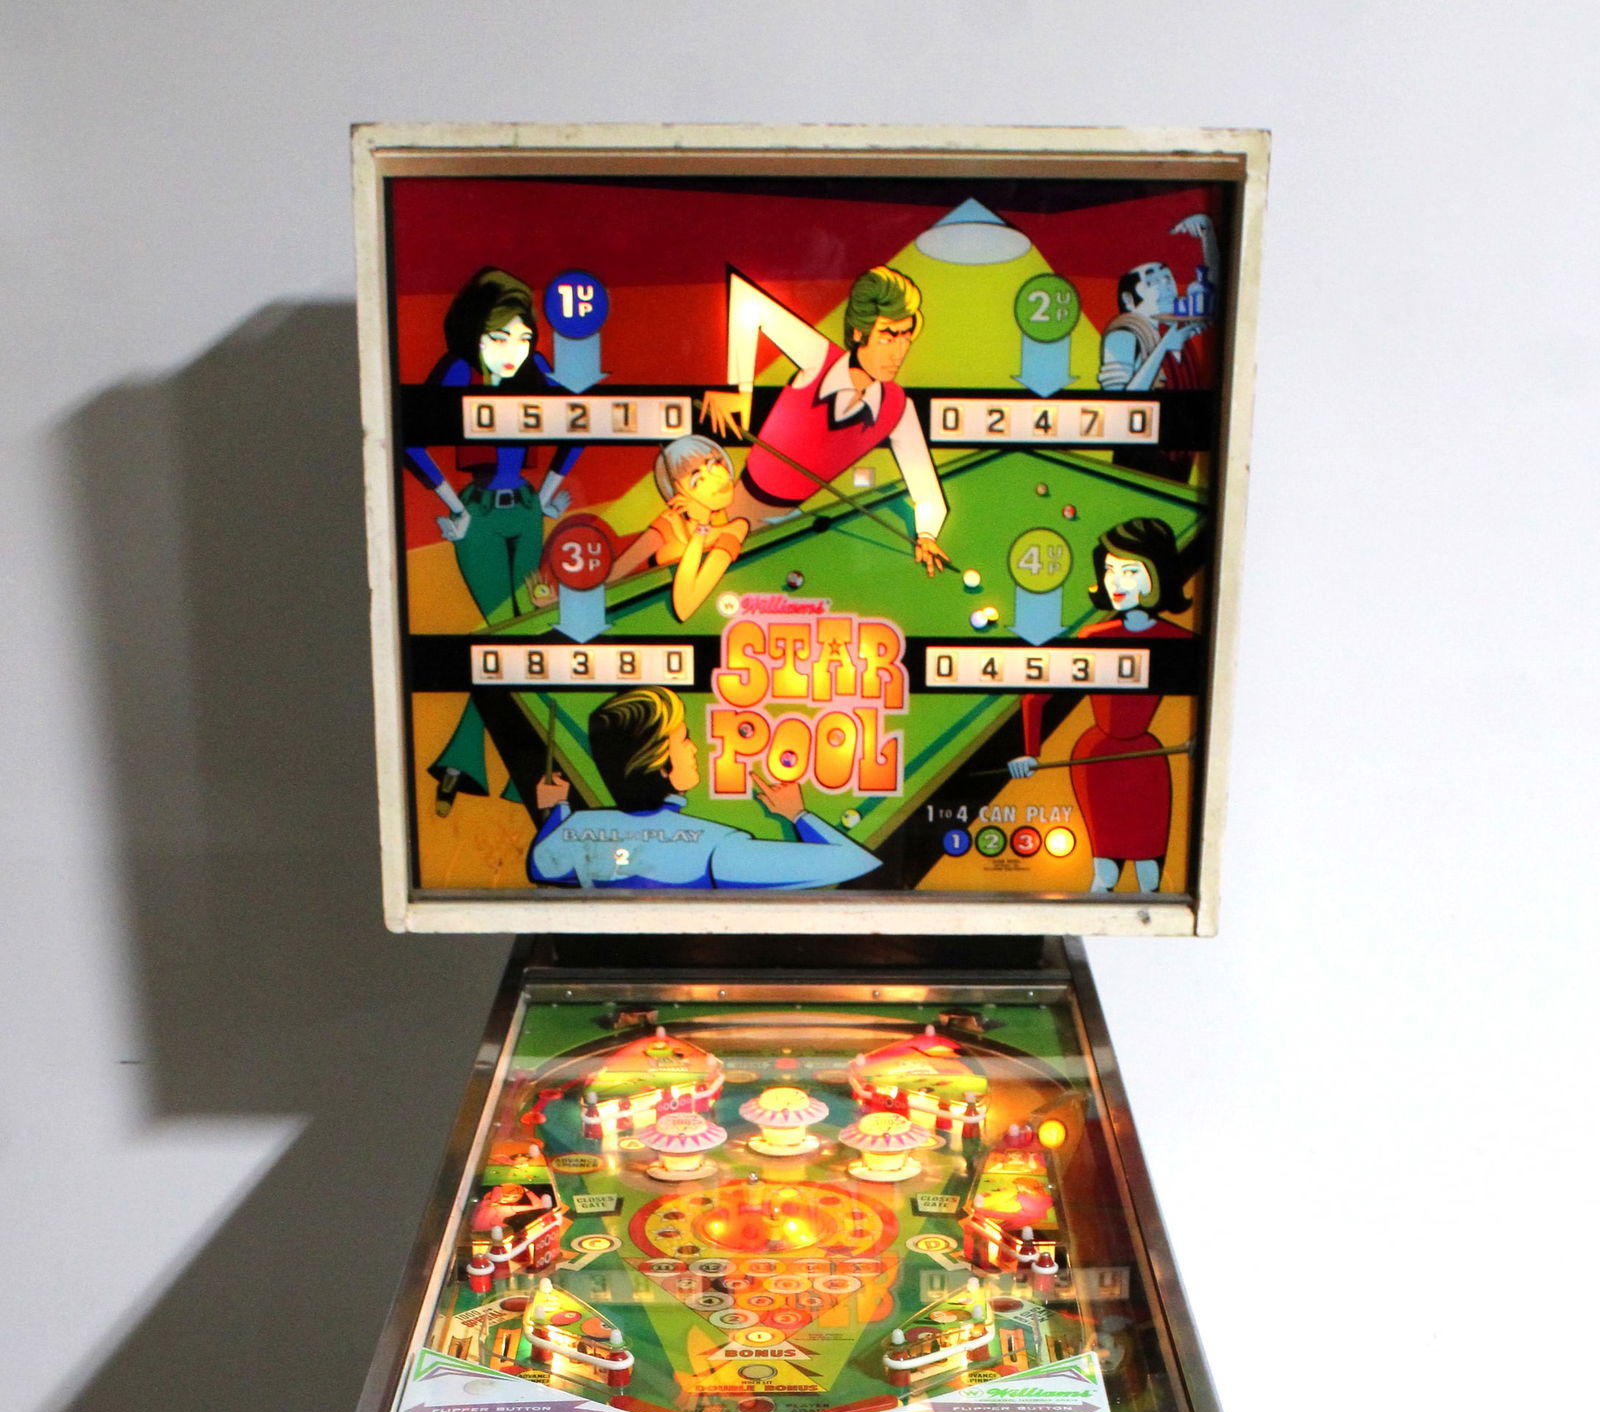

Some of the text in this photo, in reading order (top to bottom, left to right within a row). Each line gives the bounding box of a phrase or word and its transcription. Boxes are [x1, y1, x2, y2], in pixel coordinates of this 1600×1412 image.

[740, 594, 826, 615] Williams
[716, 617, 905, 709] STAR
[710, 707, 898, 795] POOL
[927, 805, 934, 822] 1
[957, 805, 968, 823] 4
[979, 805, 1016, 822] CAN
[1026, 806, 1074, 822] PLAY
[563, 829, 624, 842] BALL
[642, 829, 704, 843] PLAY
[951, 834, 960, 849] 1
[985, 834, 999, 849] 2
[1018, 834, 1034, 850] 3
[614, 848, 630, 865] 2
[577, 1195, 615, 1203] CLOSES
[724, 1349, 797, 1357] BONUS
[986, 1388, 1093, 1398] Williams
